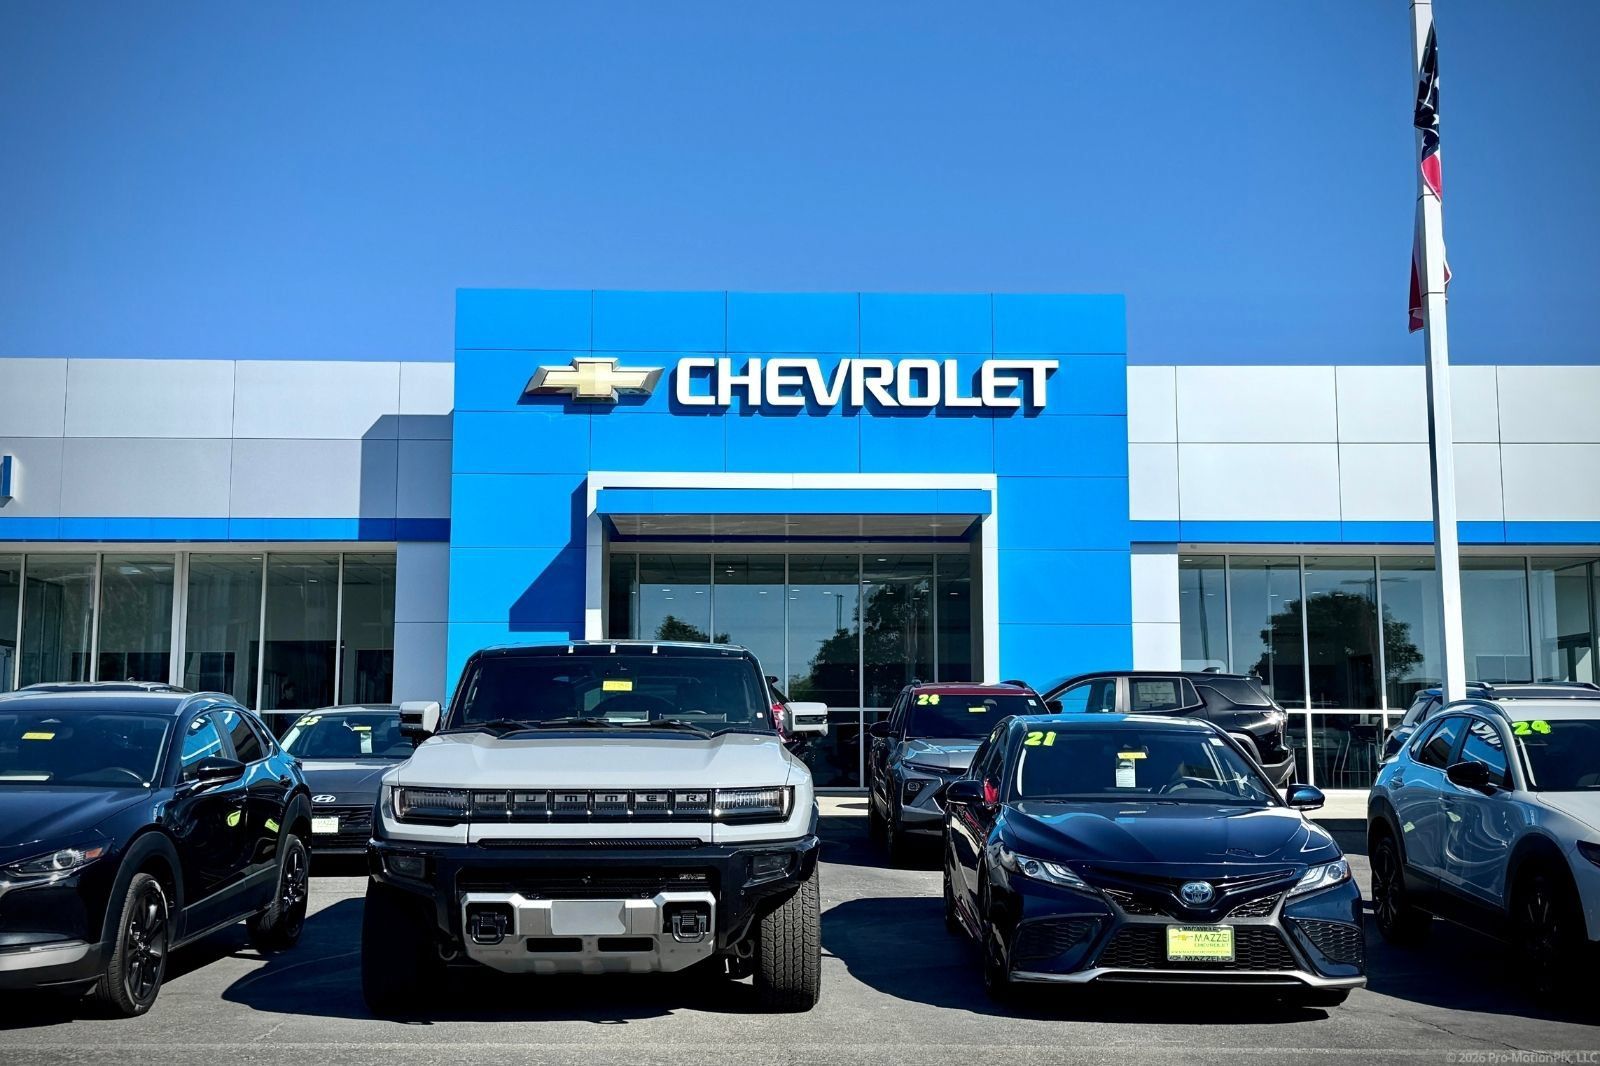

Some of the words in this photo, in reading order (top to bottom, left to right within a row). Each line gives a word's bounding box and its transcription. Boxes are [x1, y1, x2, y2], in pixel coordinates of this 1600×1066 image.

[675, 356, 1060, 408] CHEVROLET
[916, 693, 940, 706] 24
[1023, 731, 1057, 747] 21
[485, 794, 698, 802] HUMMER
[1194, 933, 1230, 942] MAZZEI
